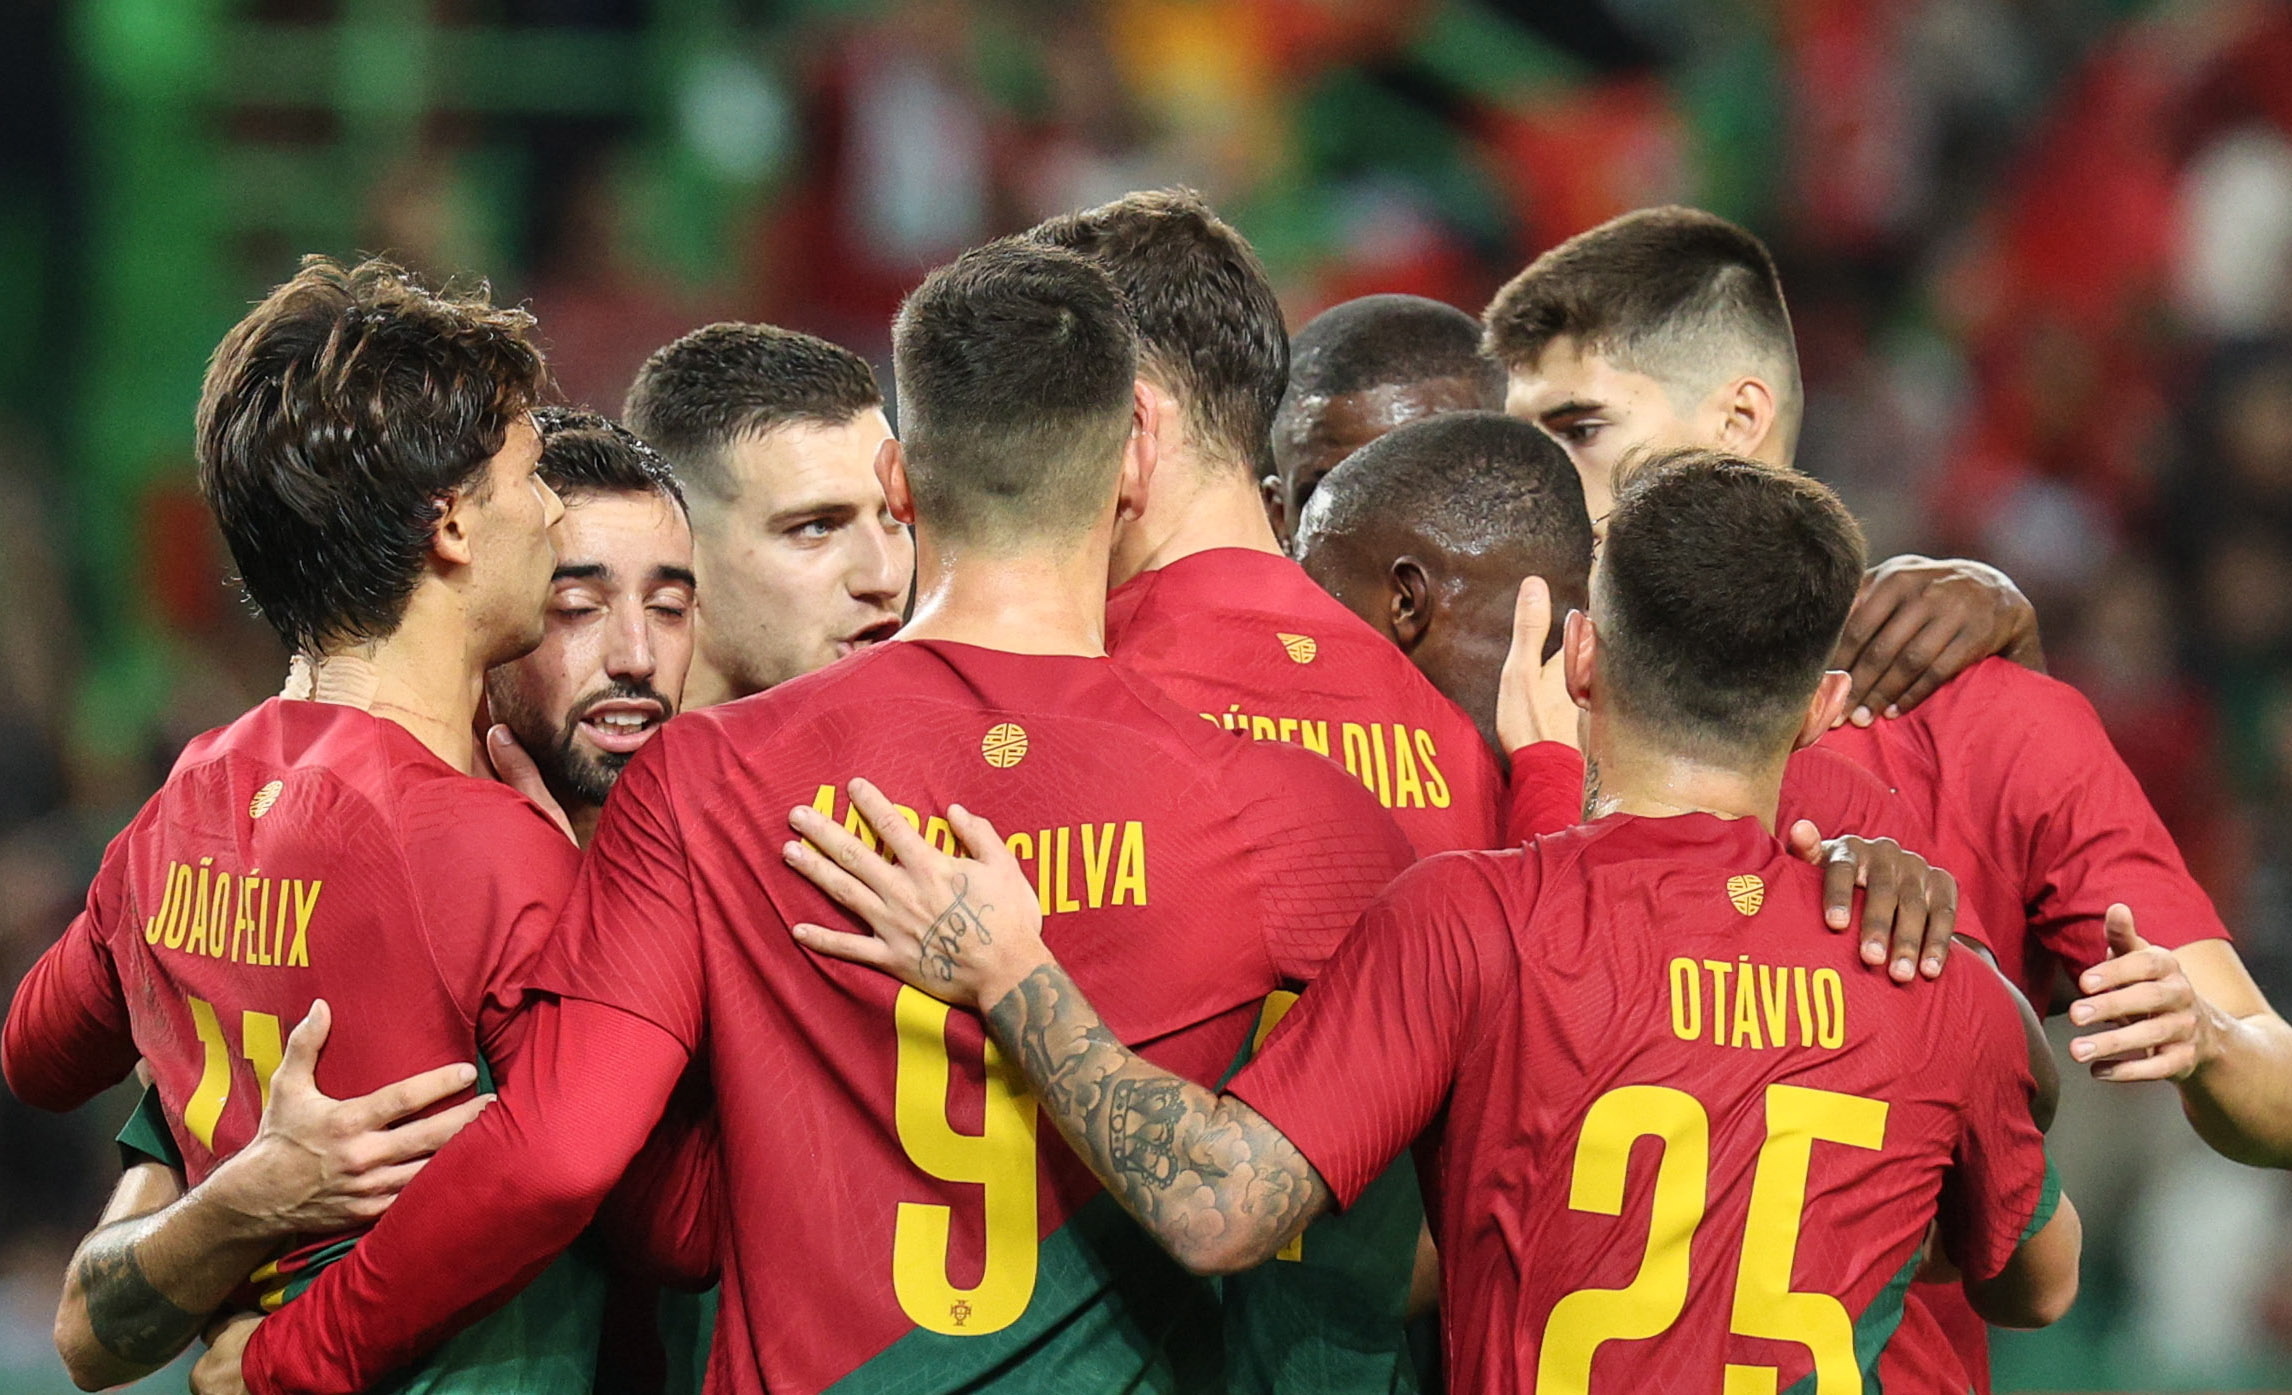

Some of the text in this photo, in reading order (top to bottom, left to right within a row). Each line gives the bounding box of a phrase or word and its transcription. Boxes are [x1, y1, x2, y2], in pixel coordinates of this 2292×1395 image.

[1342, 722, 1451, 809] DIAS
[145, 856, 323, 967] JOÃO FÉLIX
[1669, 955, 1845, 1050] OTÁVIO
[892, 984, 1038, 1336] 9
[1535, 1083, 1890, 1395] 25
